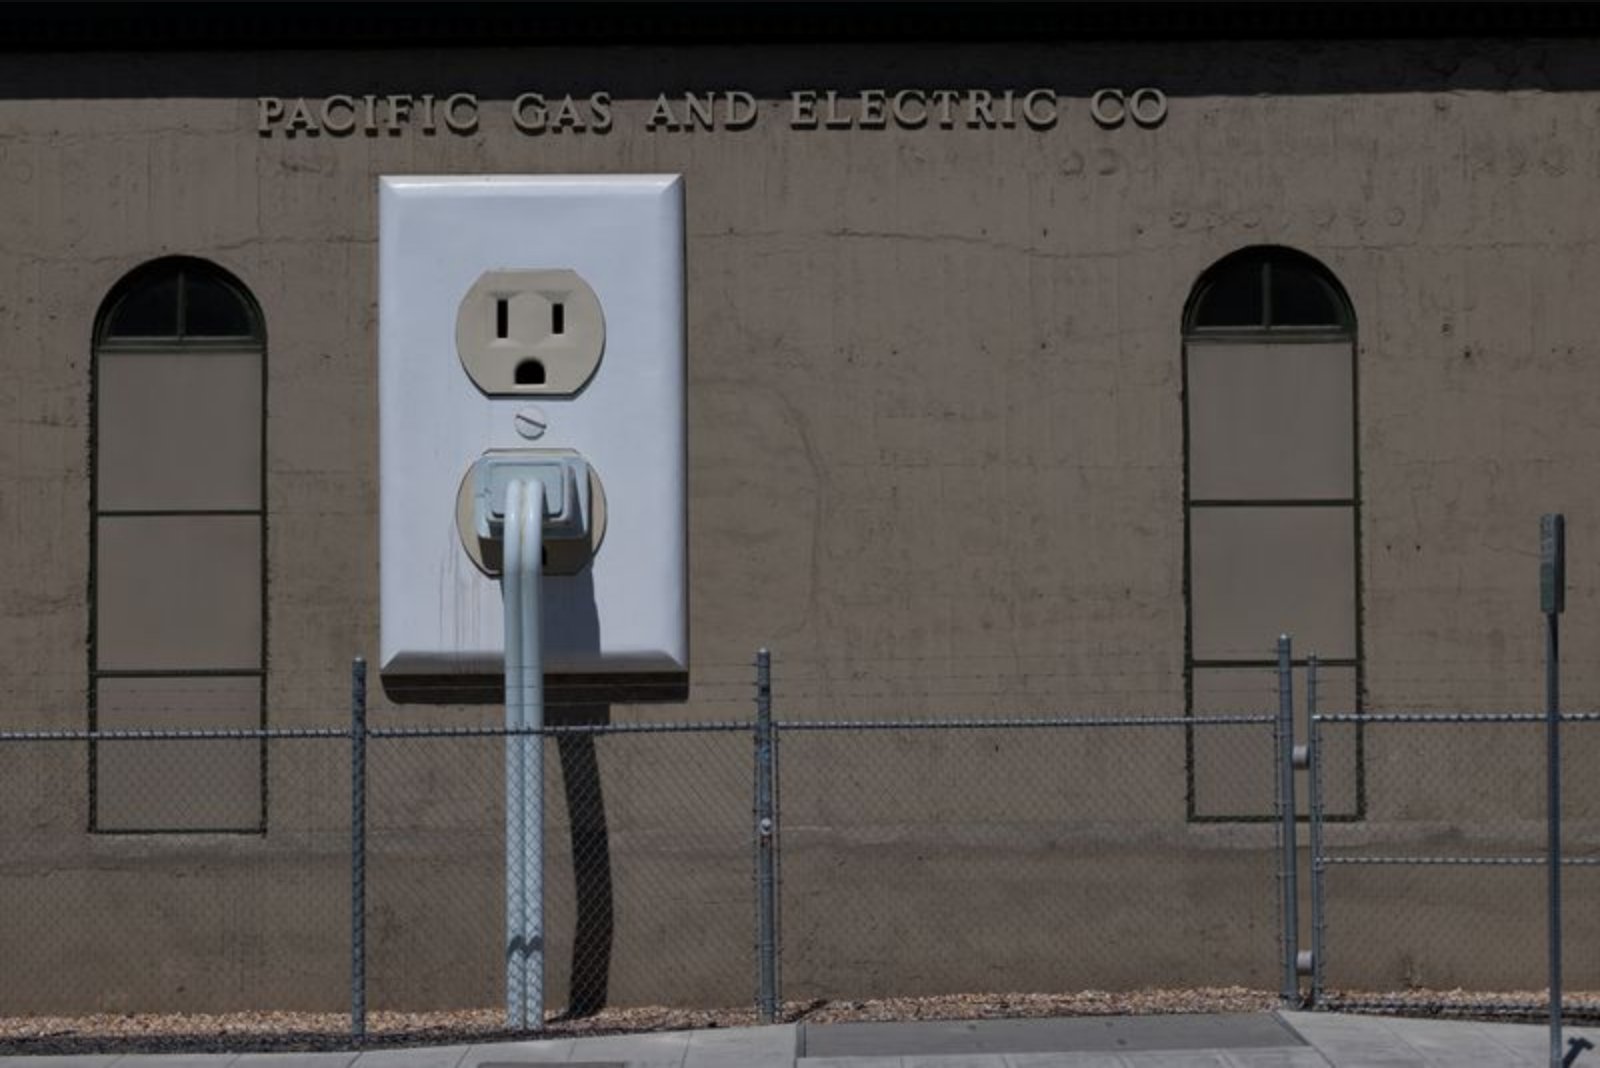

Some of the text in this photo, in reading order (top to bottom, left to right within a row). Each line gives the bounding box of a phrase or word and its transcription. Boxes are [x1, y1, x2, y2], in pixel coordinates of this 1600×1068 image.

[258, 87, 1168, 135] PACIFIC GAS AND ELECTRIC CO
